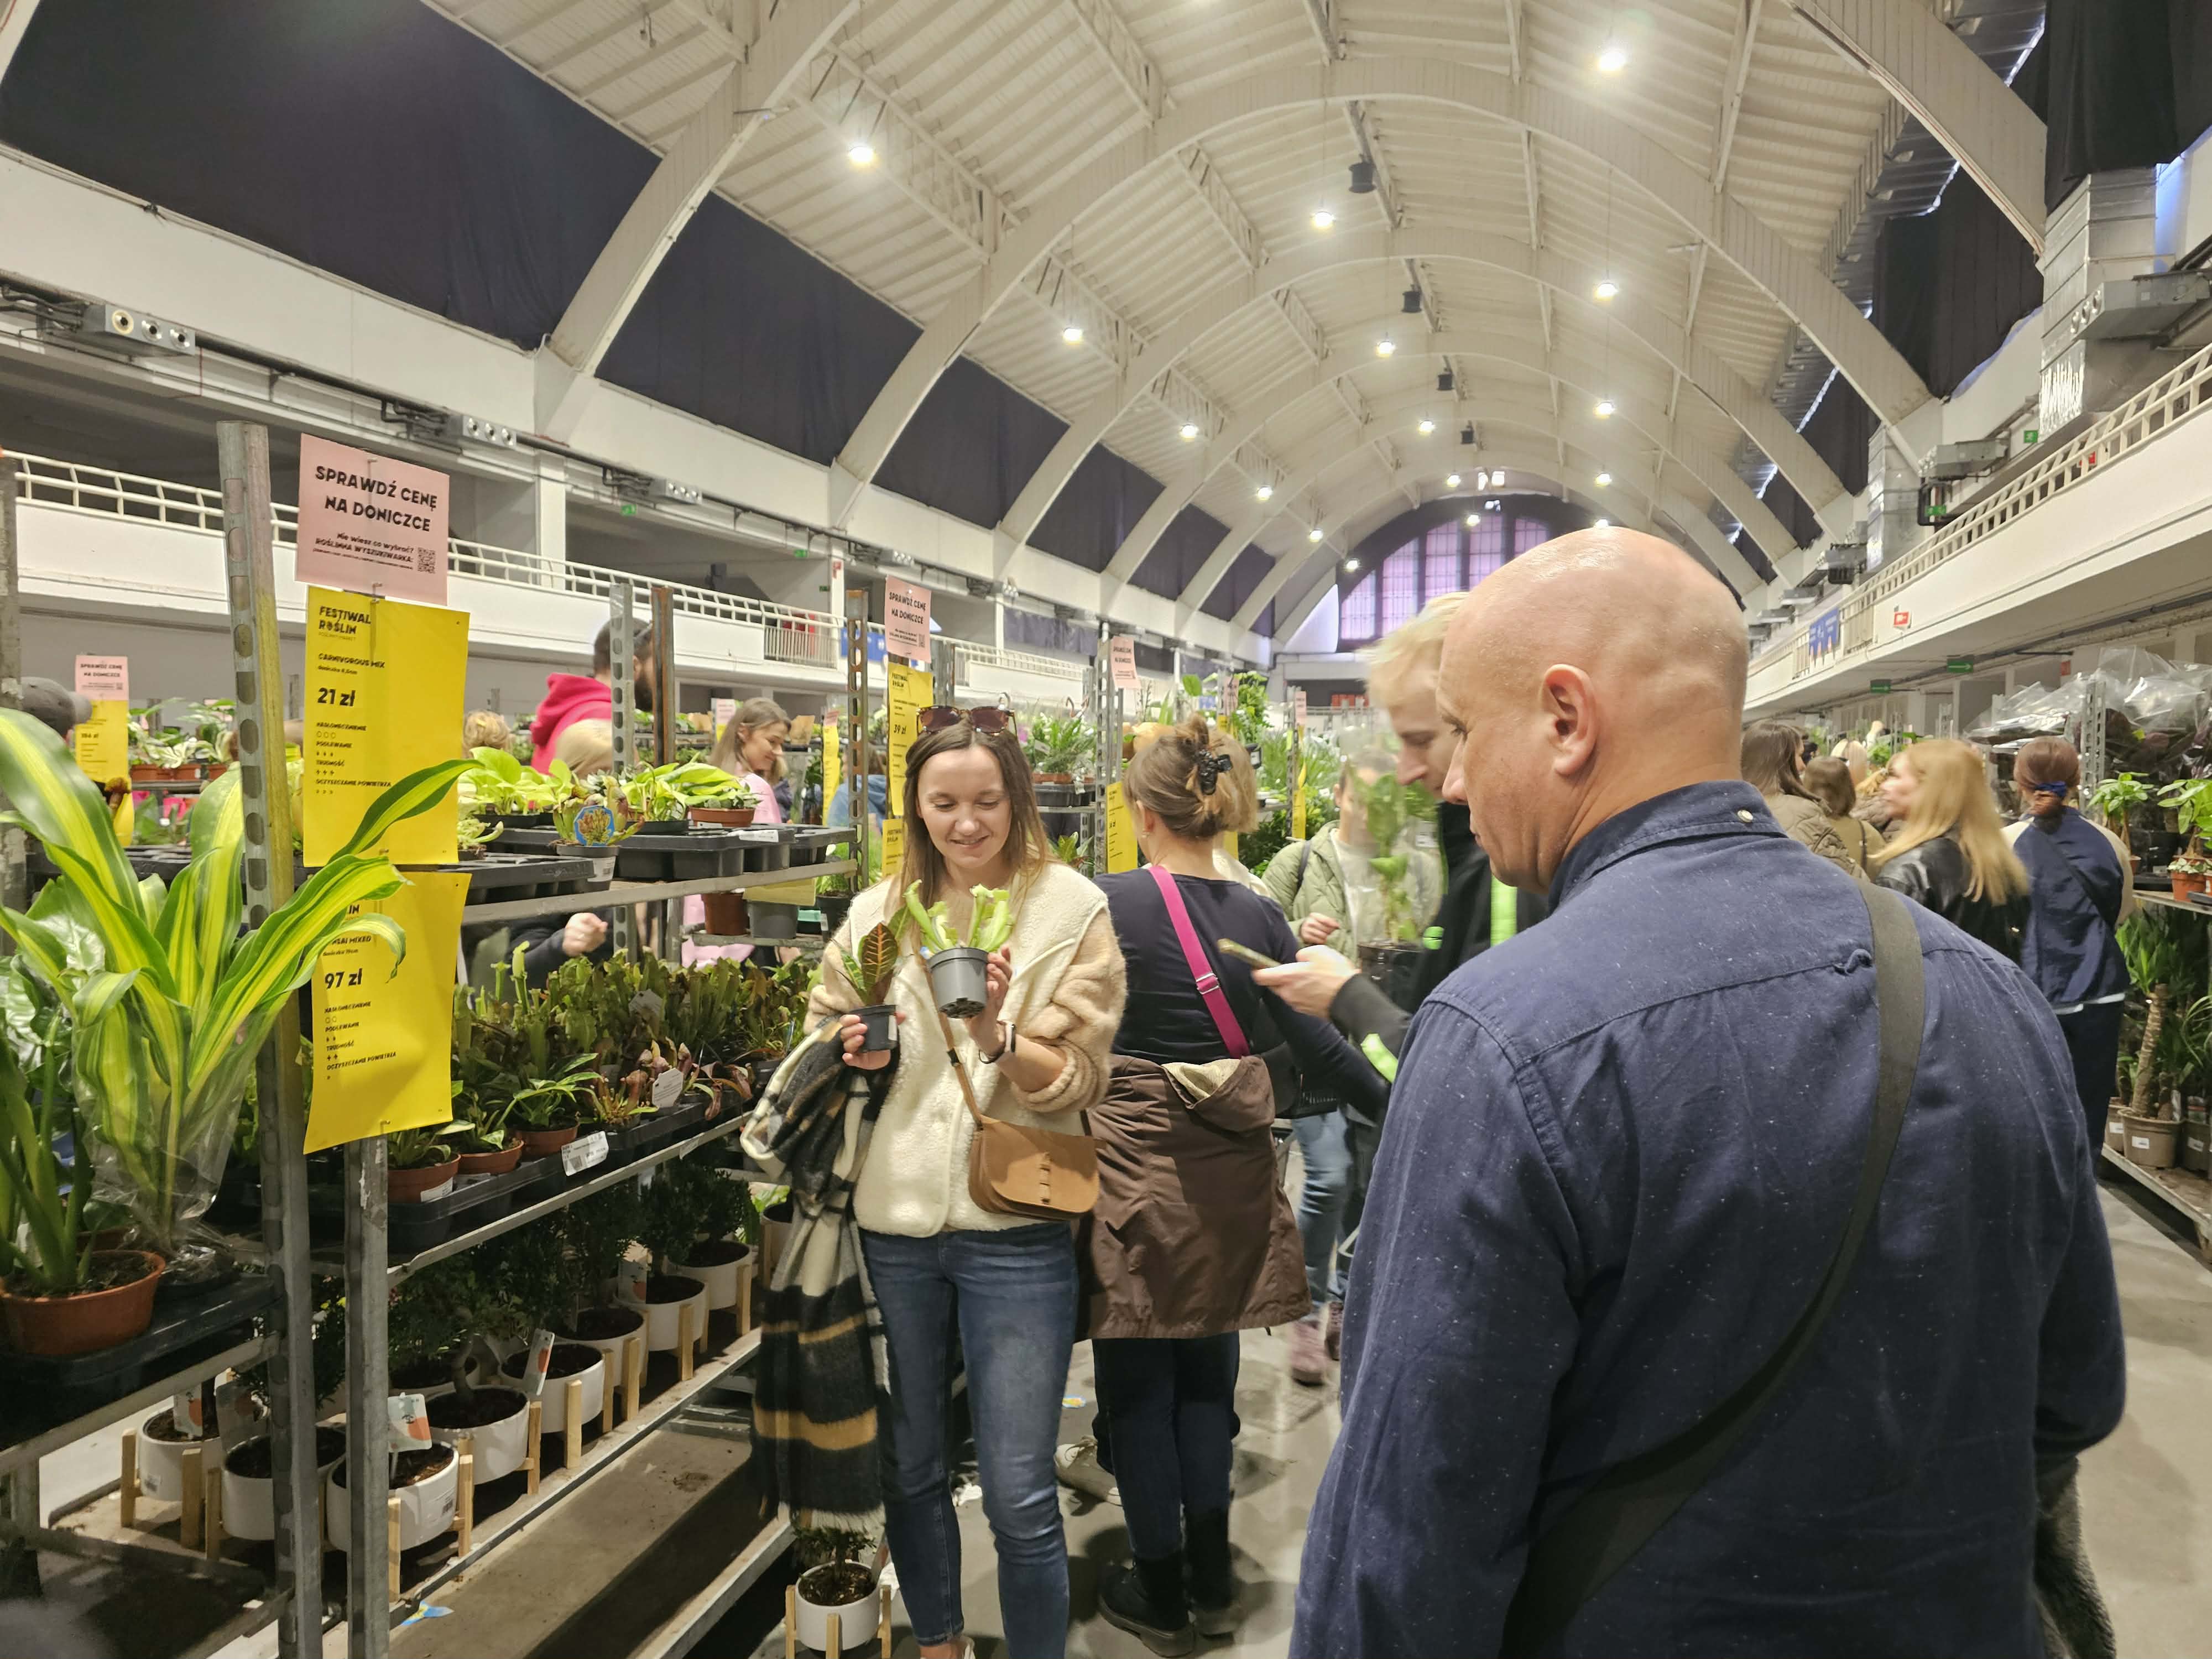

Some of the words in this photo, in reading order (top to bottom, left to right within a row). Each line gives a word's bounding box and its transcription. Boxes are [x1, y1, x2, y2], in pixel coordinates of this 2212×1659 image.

[315, 466, 397, 498] SPRAWDŹ
[400, 487, 438, 511] CENĘ
[325, 495, 347, 513] NA
[352, 502, 431, 531] DONICZCE
[319, 606, 372, 624] FESTIWAL
[891, 608, 899, 617] NA
[317, 687, 336, 705] 21
[340, 690, 356, 707] zł
[894, 724, 901, 734] 39
[901, 725, 907, 735] zł
[325, 971, 345, 989] 97
[348, 968, 363, 987] zł
